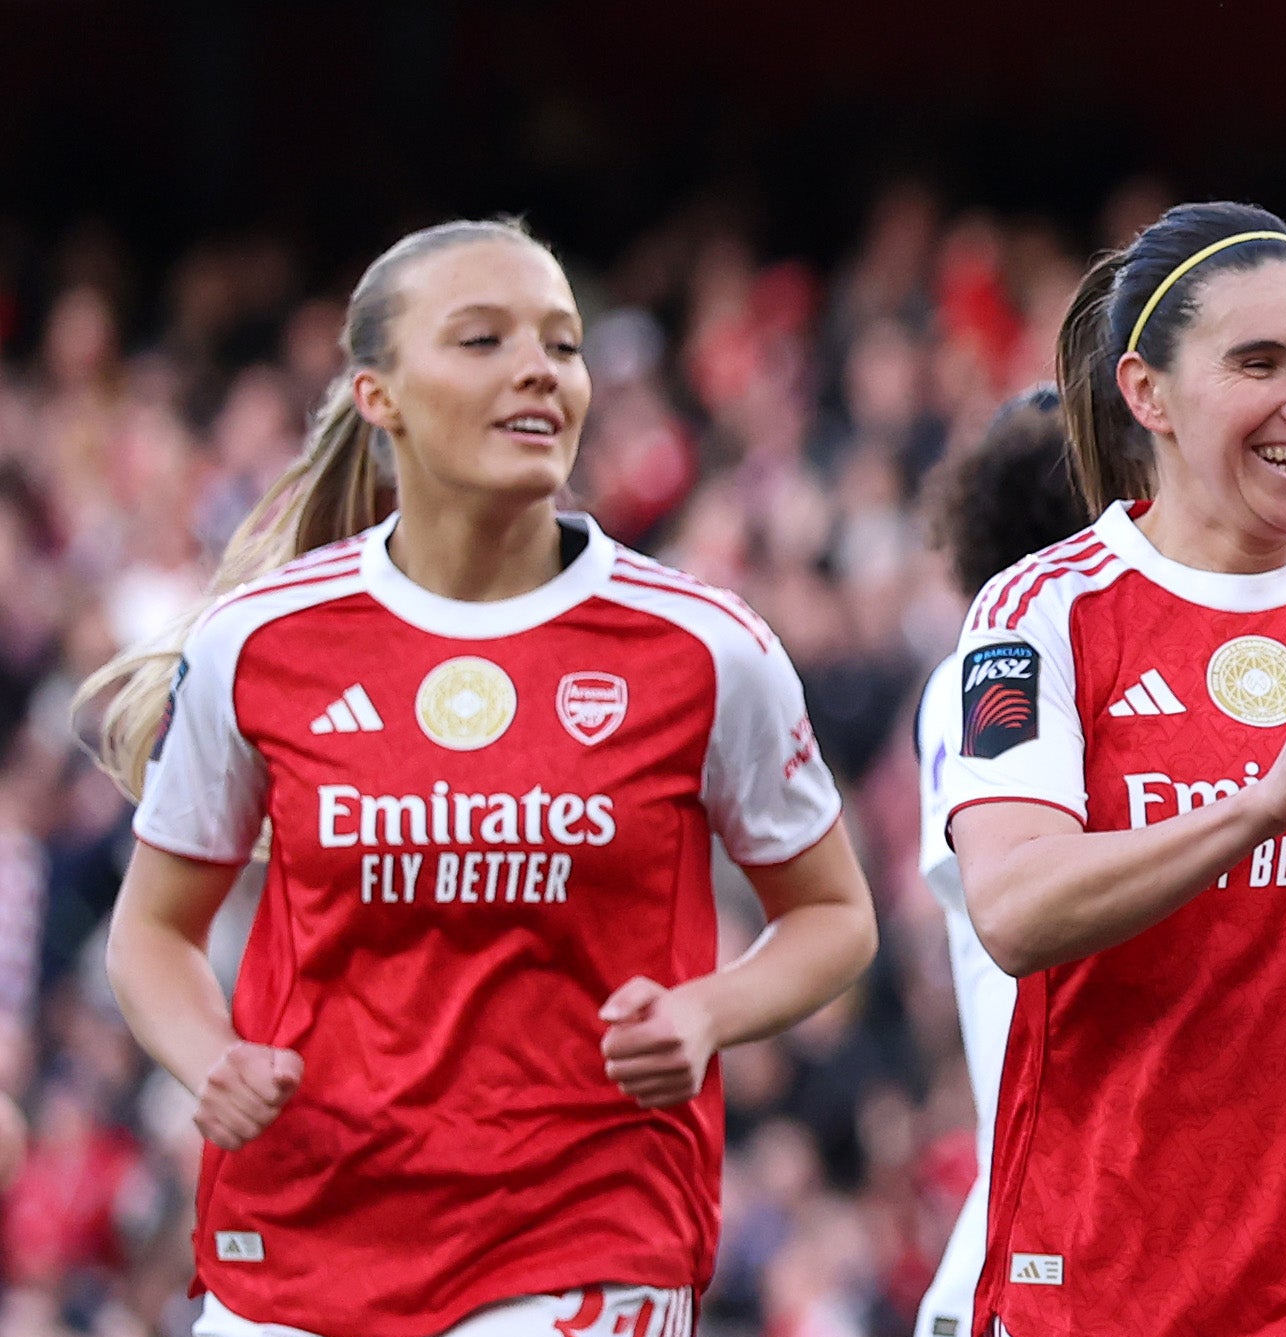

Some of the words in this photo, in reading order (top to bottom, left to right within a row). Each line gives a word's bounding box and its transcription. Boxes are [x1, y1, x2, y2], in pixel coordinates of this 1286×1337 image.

[964, 658, 1034, 693] WSL
[317, 779, 617, 848] Emirates
[360, 852, 424, 904] FLY
[433, 850, 573, 904] BETTER
